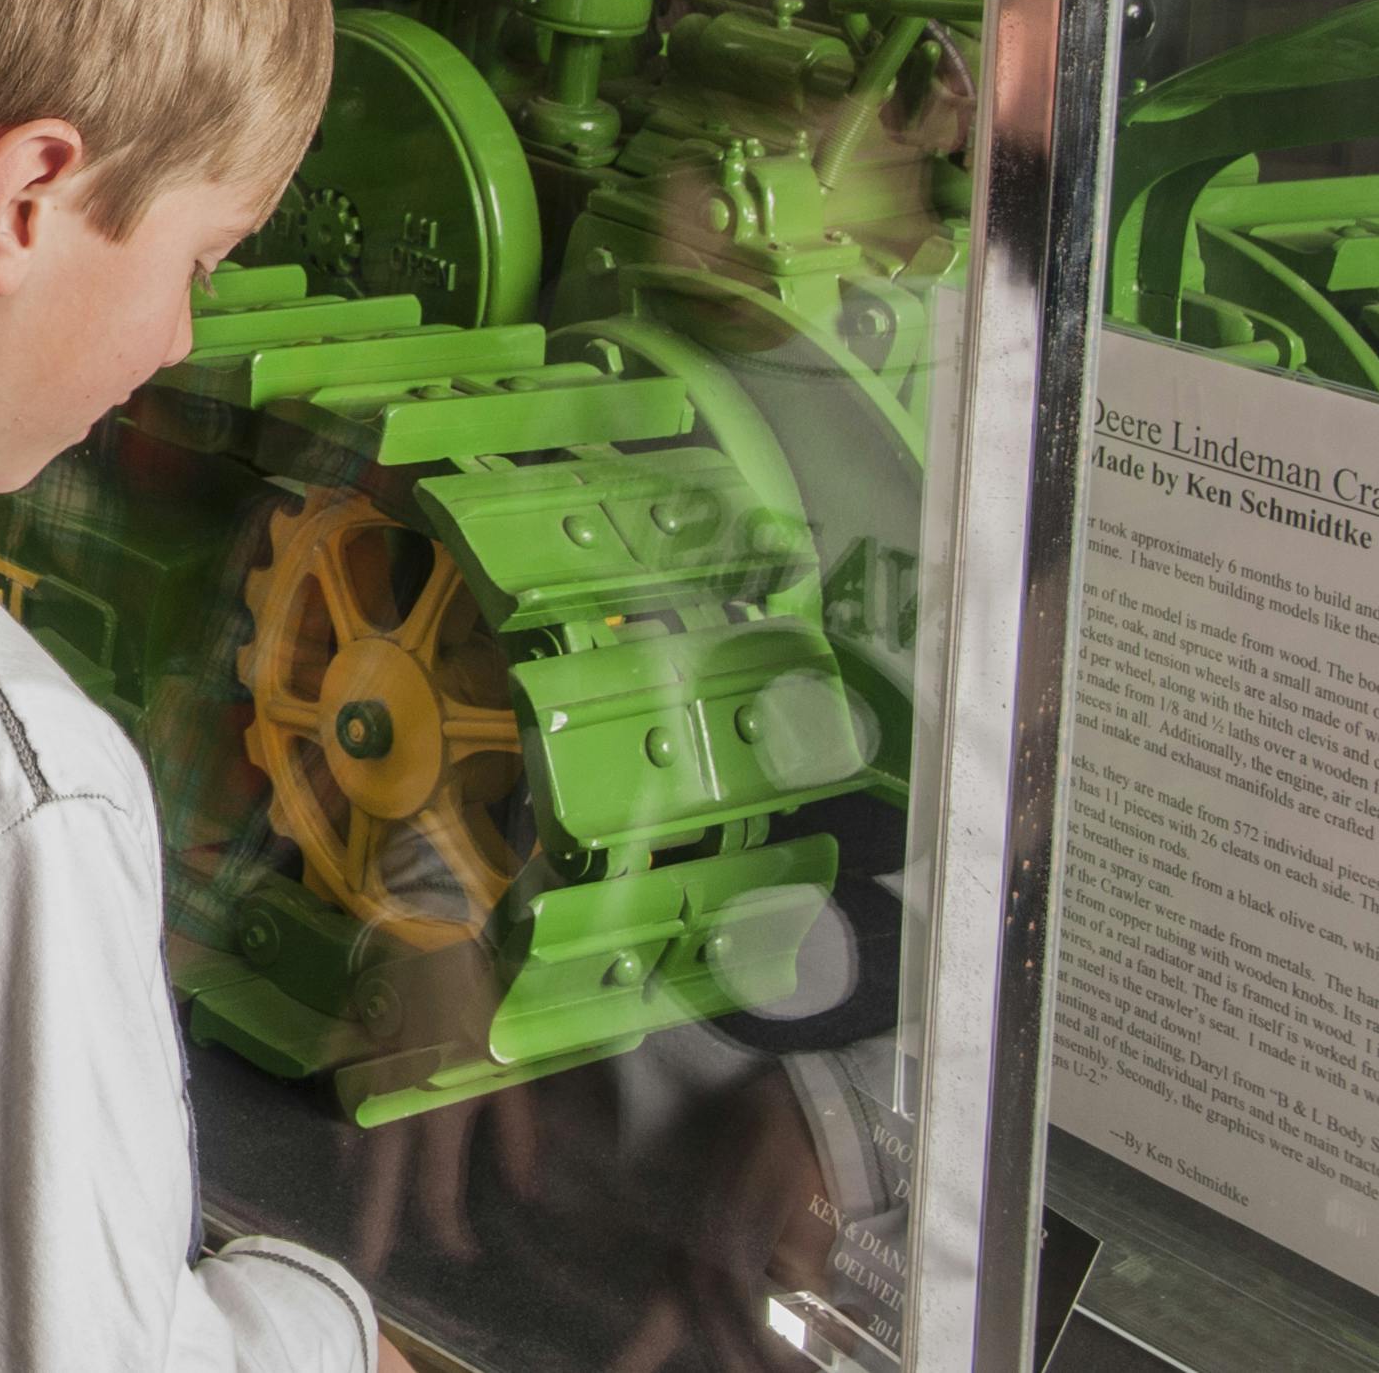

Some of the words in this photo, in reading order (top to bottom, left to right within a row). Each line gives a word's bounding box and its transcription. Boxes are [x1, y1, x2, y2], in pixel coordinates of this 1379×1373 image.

[1091, 445, 1145, 480] Made
[1152, 461, 1179, 496] by
[1186, 472, 1232, 508] Ken
[1240, 489, 1372, 550] Schmidtke
[1172, 420, 1321, 493] Lindeman
[1099, 518, 1127, 539] took
[1131, 531, 1224, 573] approximately
[1228, 559, 1237, 574] 6
[1241, 566, 1291, 592] months
[1314, 585, 1351, 611] build
[1139, 551, 1170, 576] have
[1174, 563, 1204, 587] been
[1209, 575, 1265, 611] building
[1269, 599, 1319, 625] models
[1324, 612, 1351, 635] like
[1119, 592, 1138, 610] the
[1142, 603, 1182, 626] model
[1200, 623, 1237, 644] made
[1241, 632, 1274, 657] from
[1326, 661, 1354, 685] The
[1153, 629, 1176, 646] and
[1179, 639, 1223, 662] spruce
[1227, 654, 1256, 675] with
[1273, 671, 1311, 694] small
[1314, 686, 1369, 715] amount
[1091, 652, 1111, 668] per
[1159, 675, 1196, 703] along
[1200, 691, 1229, 712] with
[1233, 702, 1255, 721] the
[1258, 709, 1293, 736] hitch
[1297, 726, 1339, 753] clevis
[1343, 746, 1369, 766] and
[1117, 640, 1140, 657] and
[1144, 648, 1190, 674] tension
[1195, 666, 1240, 692] wheels
[1244, 685, 1266, 701] are
[1269, 692, 1298, 713] also
[1301, 706, 1341, 729] made
[1086, 673, 1121, 694] made
[1125, 683, 1155, 707] from
[1161, 696, 1179, 716] 1/8
[1183, 709, 1208, 727] and
[1228, 721, 1260, 747] laths
[1264, 740, 1296, 761] over
[1312, 758, 1369, 790] wooden
[1075, 713, 1098, 730] and
[1102, 719, 1140, 746] intake
[1144, 740, 1167, 758] and
[1171, 751, 1221, 780] exhaust
[1225, 772, 1294, 809] manifolds
[1298, 802, 1320, 819] are
[1324, 813, 1374, 841] crafted
[1103, 765, 1129, 790] they
[1134, 781, 1154, 798] are
[1158, 791, 1193, 815] made
[1197, 804, 1229, 831] from
[1233, 820, 1259, 842] 572
[1263, 831, 1333, 872] individual
[1251, 755, 1273, 776] the
[1332, 789, 1352, 807] air
[1074, 799, 1105, 824] tread
[1109, 815, 1155, 845] tension
[1106, 787, 1118, 806] 11
[1124, 799, 1164, 826] pieces
[1168, 819, 1197, 840] with
[1201, 829, 1217, 848] 26
[1221, 840, 1260, 866] cleats
[1285, 868, 1317, 889] each
[1083, 823, 1135, 858] breather
[1152, 858, 1188, 881] made
[1191, 871, 1223, 896] from
[1239, 889, 1275, 918] black
[1279, 910, 1315, 934] olive
[1101, 877, 1152, 910] Crawler
[1155, 904, 1186, 925] were
[1190, 919, 1225, 942] made
[1229, 932, 1262, 959] from
[1110, 863, 1145, 888] spray
[1075, 888, 1105, 913] from
[1109, 907, 1152, 933] copper
[1155, 925, 1197, 956] tubing
[1200, 945, 1230, 968] with
[1234, 960, 1288, 993] wooden
[1117, 932, 1140, 950] real
[1144, 944, 1195, 973] radiator
[1242, 983, 1291, 1017] framed
[1071, 976, 1111, 1003] moves
[1160, 1015, 1201, 1045] down!
[1077, 958, 1105, 978] steel
[1258, 1041, 1296, 1066] made
[1315, 1066, 1346, 1090] with
[1248, 1008, 1285, 1037] itself
[1303, 1037, 1357, 1071] worked
[1142, 1050, 1207, 1094] individual
[1211, 1087, 1245, 1111] parts
[1304, 1131, 1339, 1158] main
[1190, 1050, 1228, 1081] Daryl
[1233, 1071, 1265, 1098] from
[1293, 1100, 1307, 1118] &
[1327, 1115, 1365, 1148] Body
[872, 1124, 914, 1164] WOO
[1146, 1142, 1173, 1168] Ken
[1177, 1158, 1249, 1207] Schmidtke
[1206, 1108, 1265, 1144] graphics
[1269, 1138, 1303, 1163] were
[1306, 1156, 1336, 1179] also
[808, 1194, 844, 1231] KEN
[844, 1221, 858, 1242] &
[859, 1230, 907, 1278] DIAN
[868, 1314, 901, 1349] 2011
